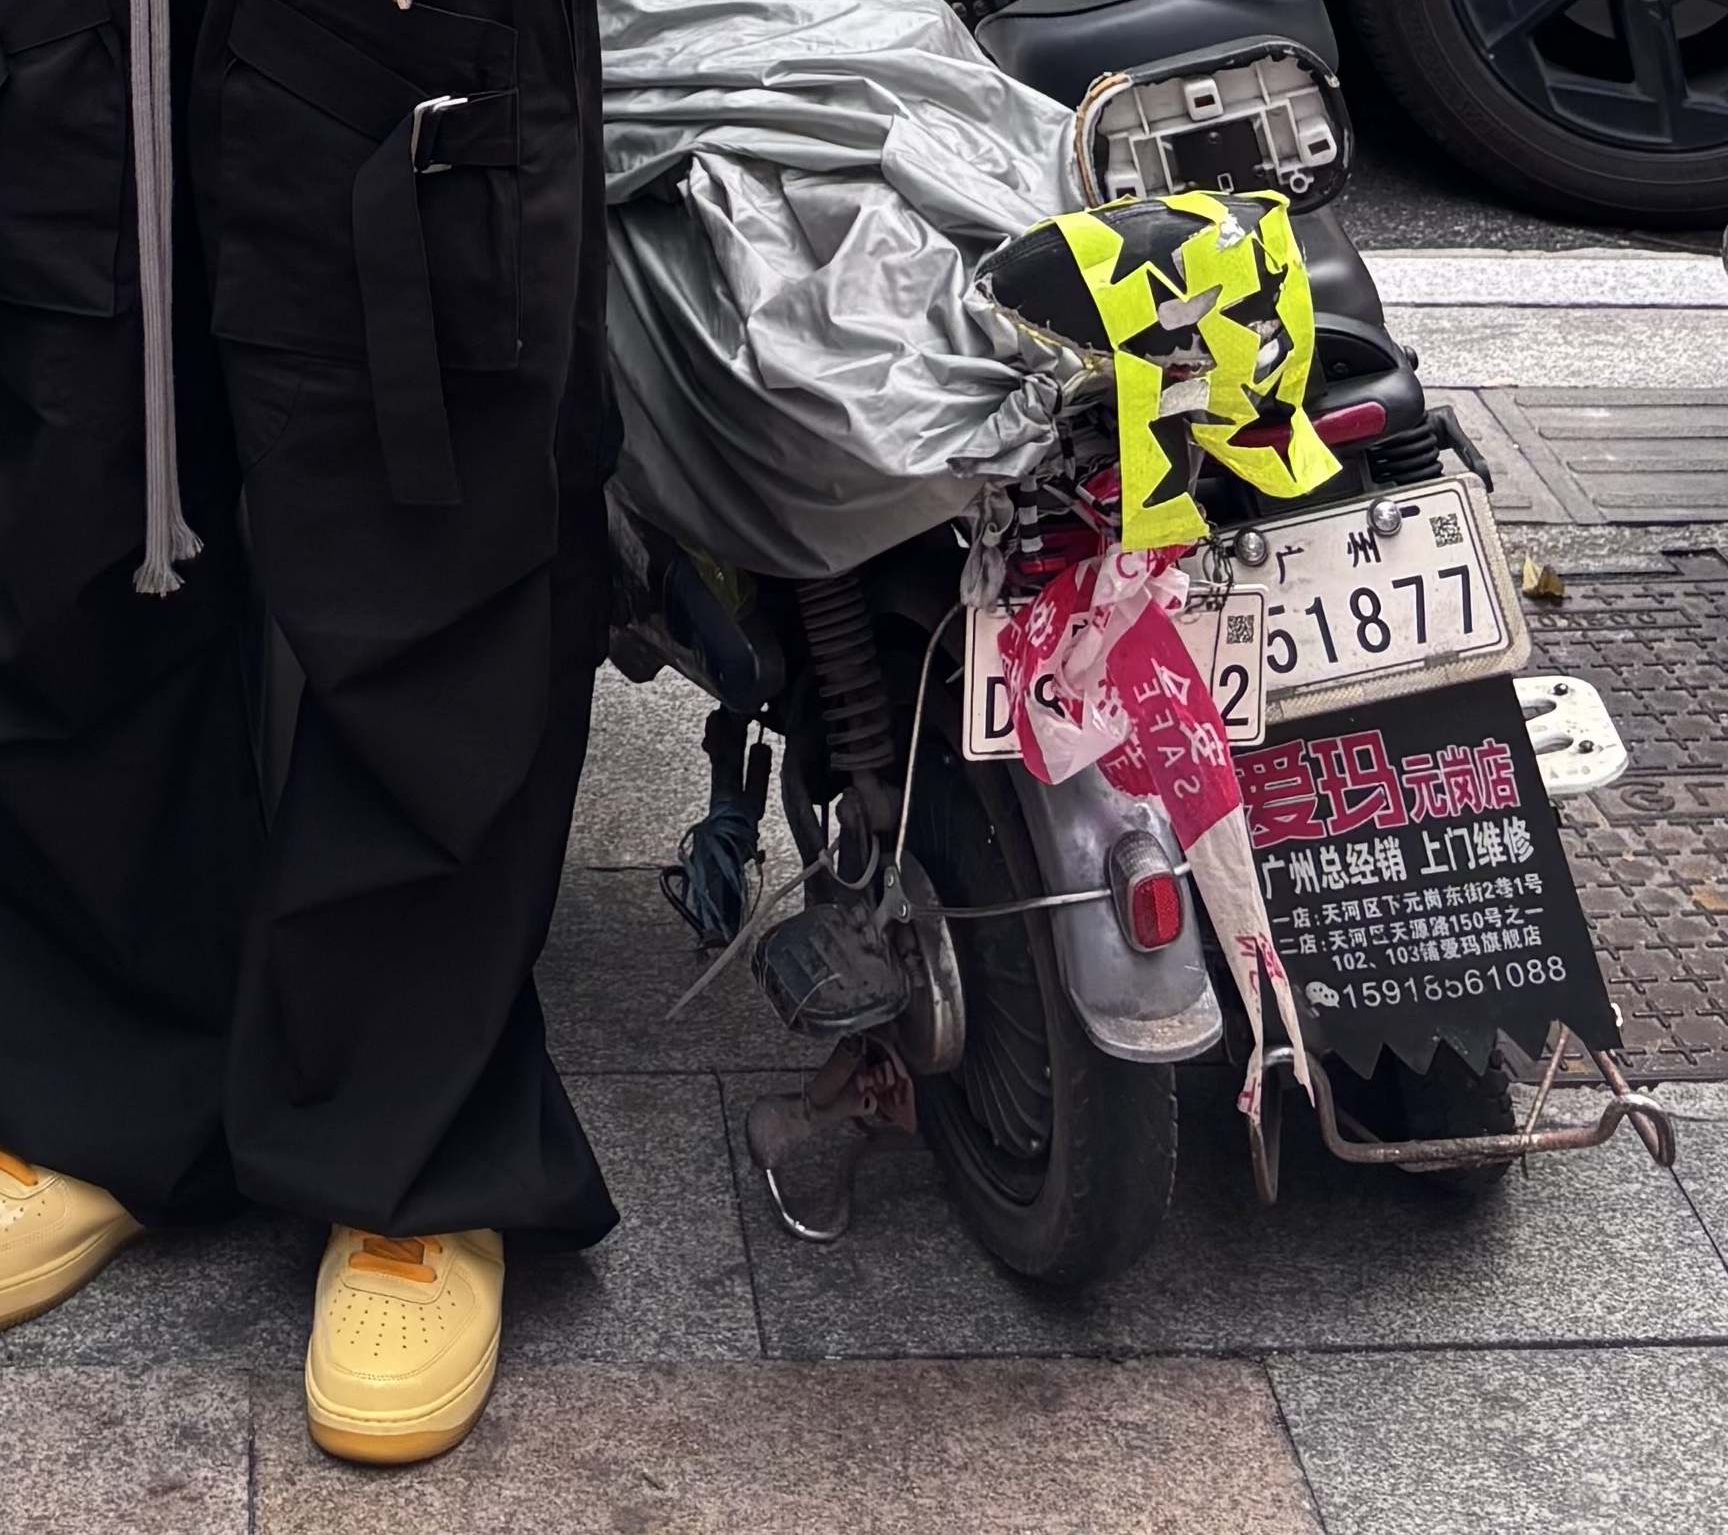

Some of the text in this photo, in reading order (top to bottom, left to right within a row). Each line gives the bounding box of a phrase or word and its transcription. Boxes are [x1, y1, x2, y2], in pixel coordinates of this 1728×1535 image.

[1275, 529, 1382, 585] 广州
[1266, 563, 1474, 675] 51877
[1261, 814, 1535, 900] 广州总经销 上门维修
